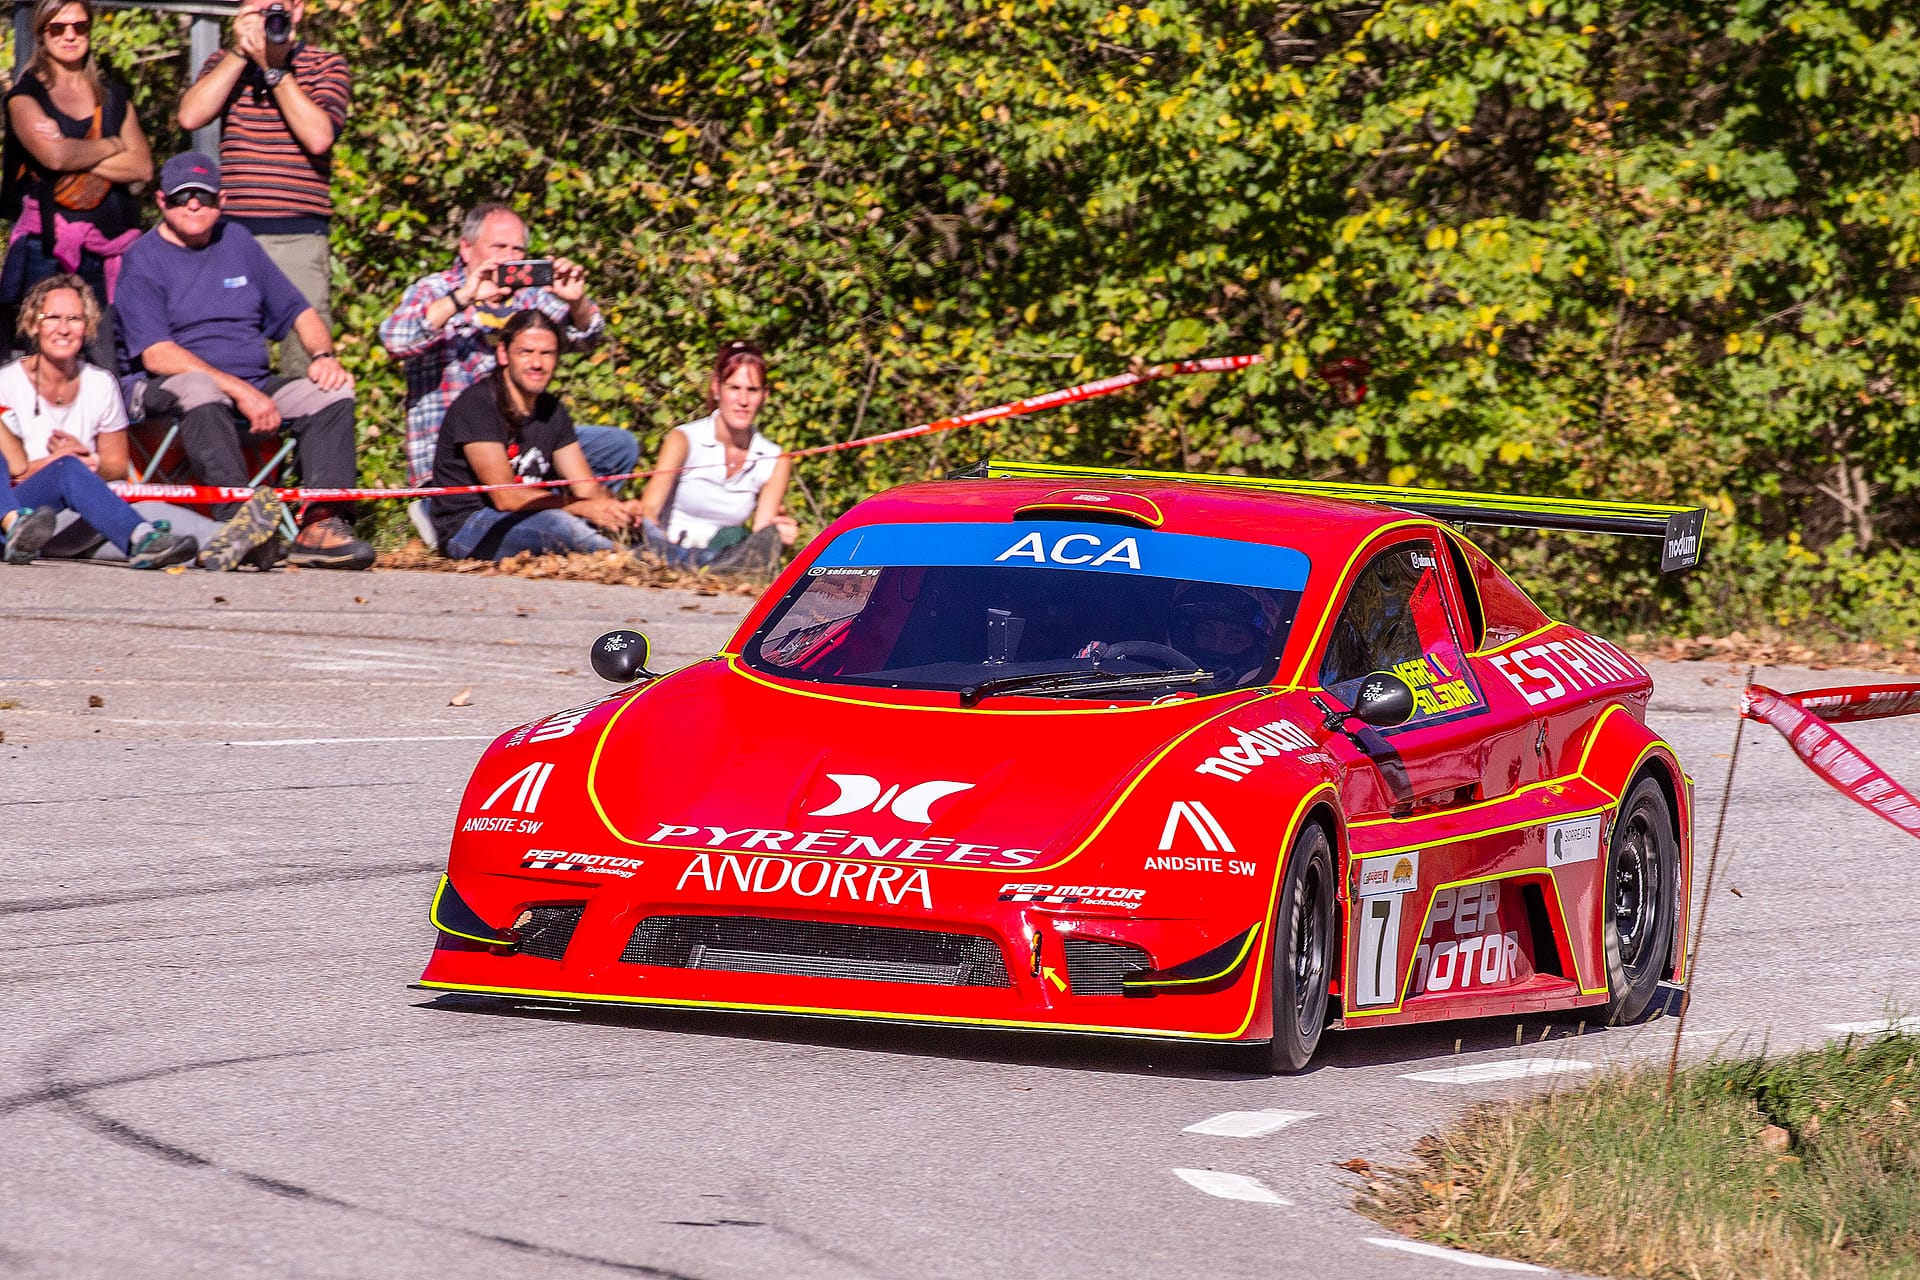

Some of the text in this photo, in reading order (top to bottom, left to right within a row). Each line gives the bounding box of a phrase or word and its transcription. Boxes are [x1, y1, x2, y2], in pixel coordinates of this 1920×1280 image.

[994, 532, 1142, 570] ACA
[1668, 530, 1696, 559] nodum
[1194, 719, 1319, 782] nodum
[462, 817, 544, 834] ANDSITE SW
[522, 849, 645, 870] PEP MOTOR
[584, 866, 636, 878] Technology
[1144, 857, 1257, 876] ANDSITE SW
[675, 853, 933, 910] ANDORRA
[998, 884, 1147, 900] PEP MOTOR
[1081, 897, 1142, 910] Technology
[1423, 880, 1500, 939] PEP
[1371, 900, 1392, 997] 7
